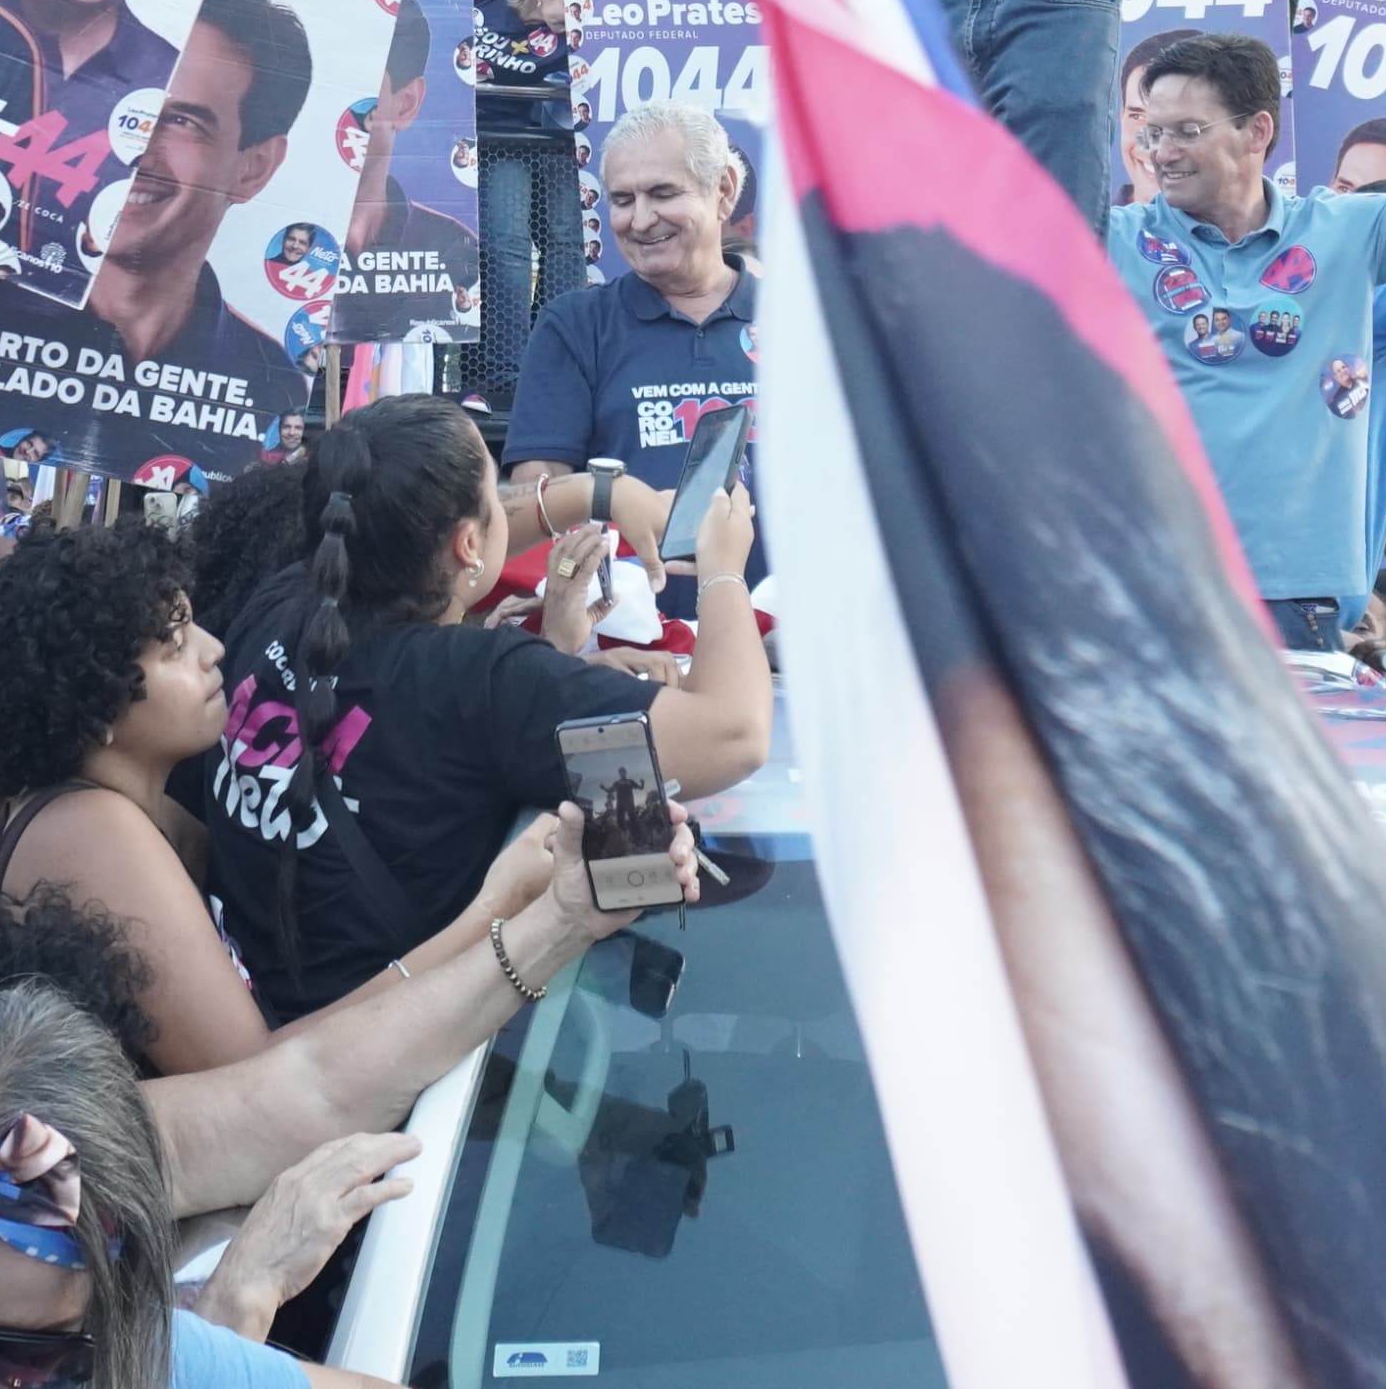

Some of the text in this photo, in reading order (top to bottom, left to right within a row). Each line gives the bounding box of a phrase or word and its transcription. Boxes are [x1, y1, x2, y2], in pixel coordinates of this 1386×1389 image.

[586, 29, 699, 41] DEPUTADO FEDERAL
[118, 114, 155, 134] 104
[311, 246, 340, 262] Neto
[357, 251, 446, 271] GENTE.
[279, 261, 329, 299] 44
[335, 275, 369, 294] DA
[77, 348, 124, 384] DA
[134, 361, 254, 407] GENTE.
[632, 386, 668, 399] VEM
[669, 384, 706, 397] COM
[707, 383, 719, 394] A
[92, 386, 140, 418] DA
[150, 396, 266, 442] BAHIA.
[637, 401, 673, 417] CO
[638, 417, 673, 432] RO
[640, 430, 684, 448] NEL
